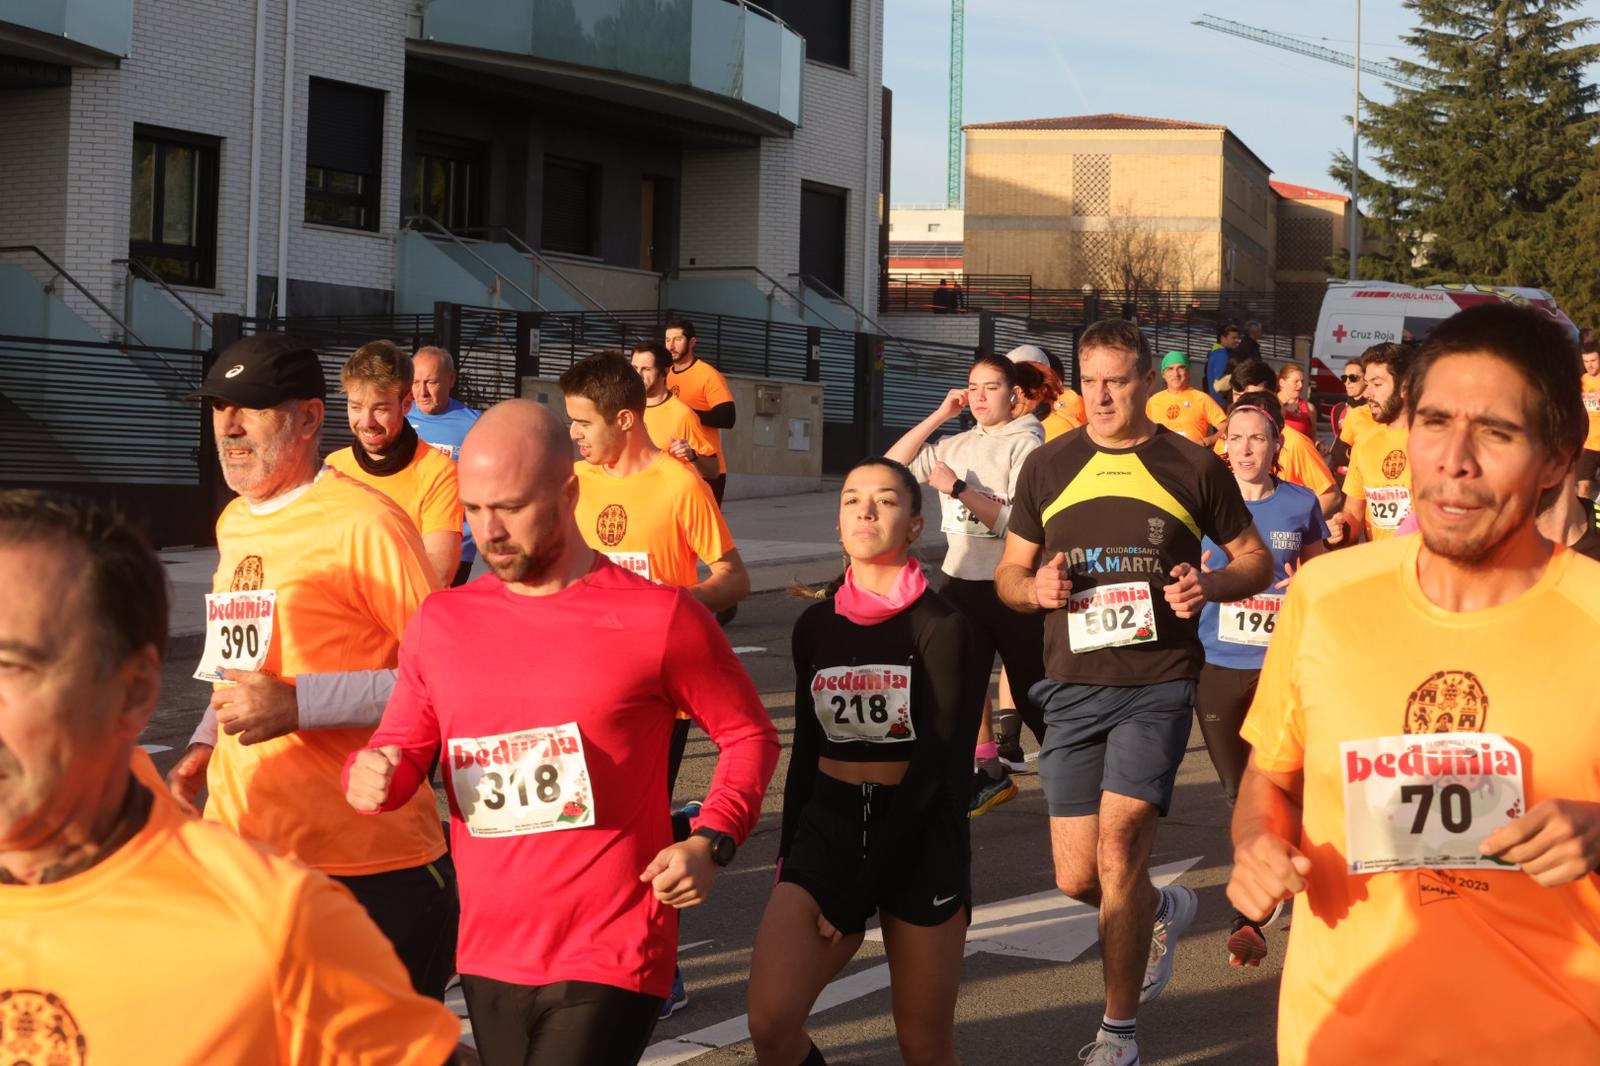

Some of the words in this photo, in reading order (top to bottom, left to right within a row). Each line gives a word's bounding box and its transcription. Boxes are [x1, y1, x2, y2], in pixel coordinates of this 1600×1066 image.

[1389, 291, 1444, 301] AMBULANCIA
[1350, 329, 1372, 340] Cruz
[1374, 330, 1395, 342] Roja
[1371, 502, 1398, 518] 329
[1106, 556, 1163, 574] MARTA
[209, 596, 271, 621] bedunia
[1070, 587, 1150, 612] bedunia
[1085, 605, 1136, 636] 502
[1235, 611, 1276, 633] 196
[221, 624, 259, 659] 390
[813, 670, 908, 691] bedunia
[831, 694, 888, 724] 218
[1346, 742, 1517, 783] bedunia
[480, 763, 562, 811] 318
[1401, 783, 1472, 835] 70
[1458, 877, 1489, 892] 2023
